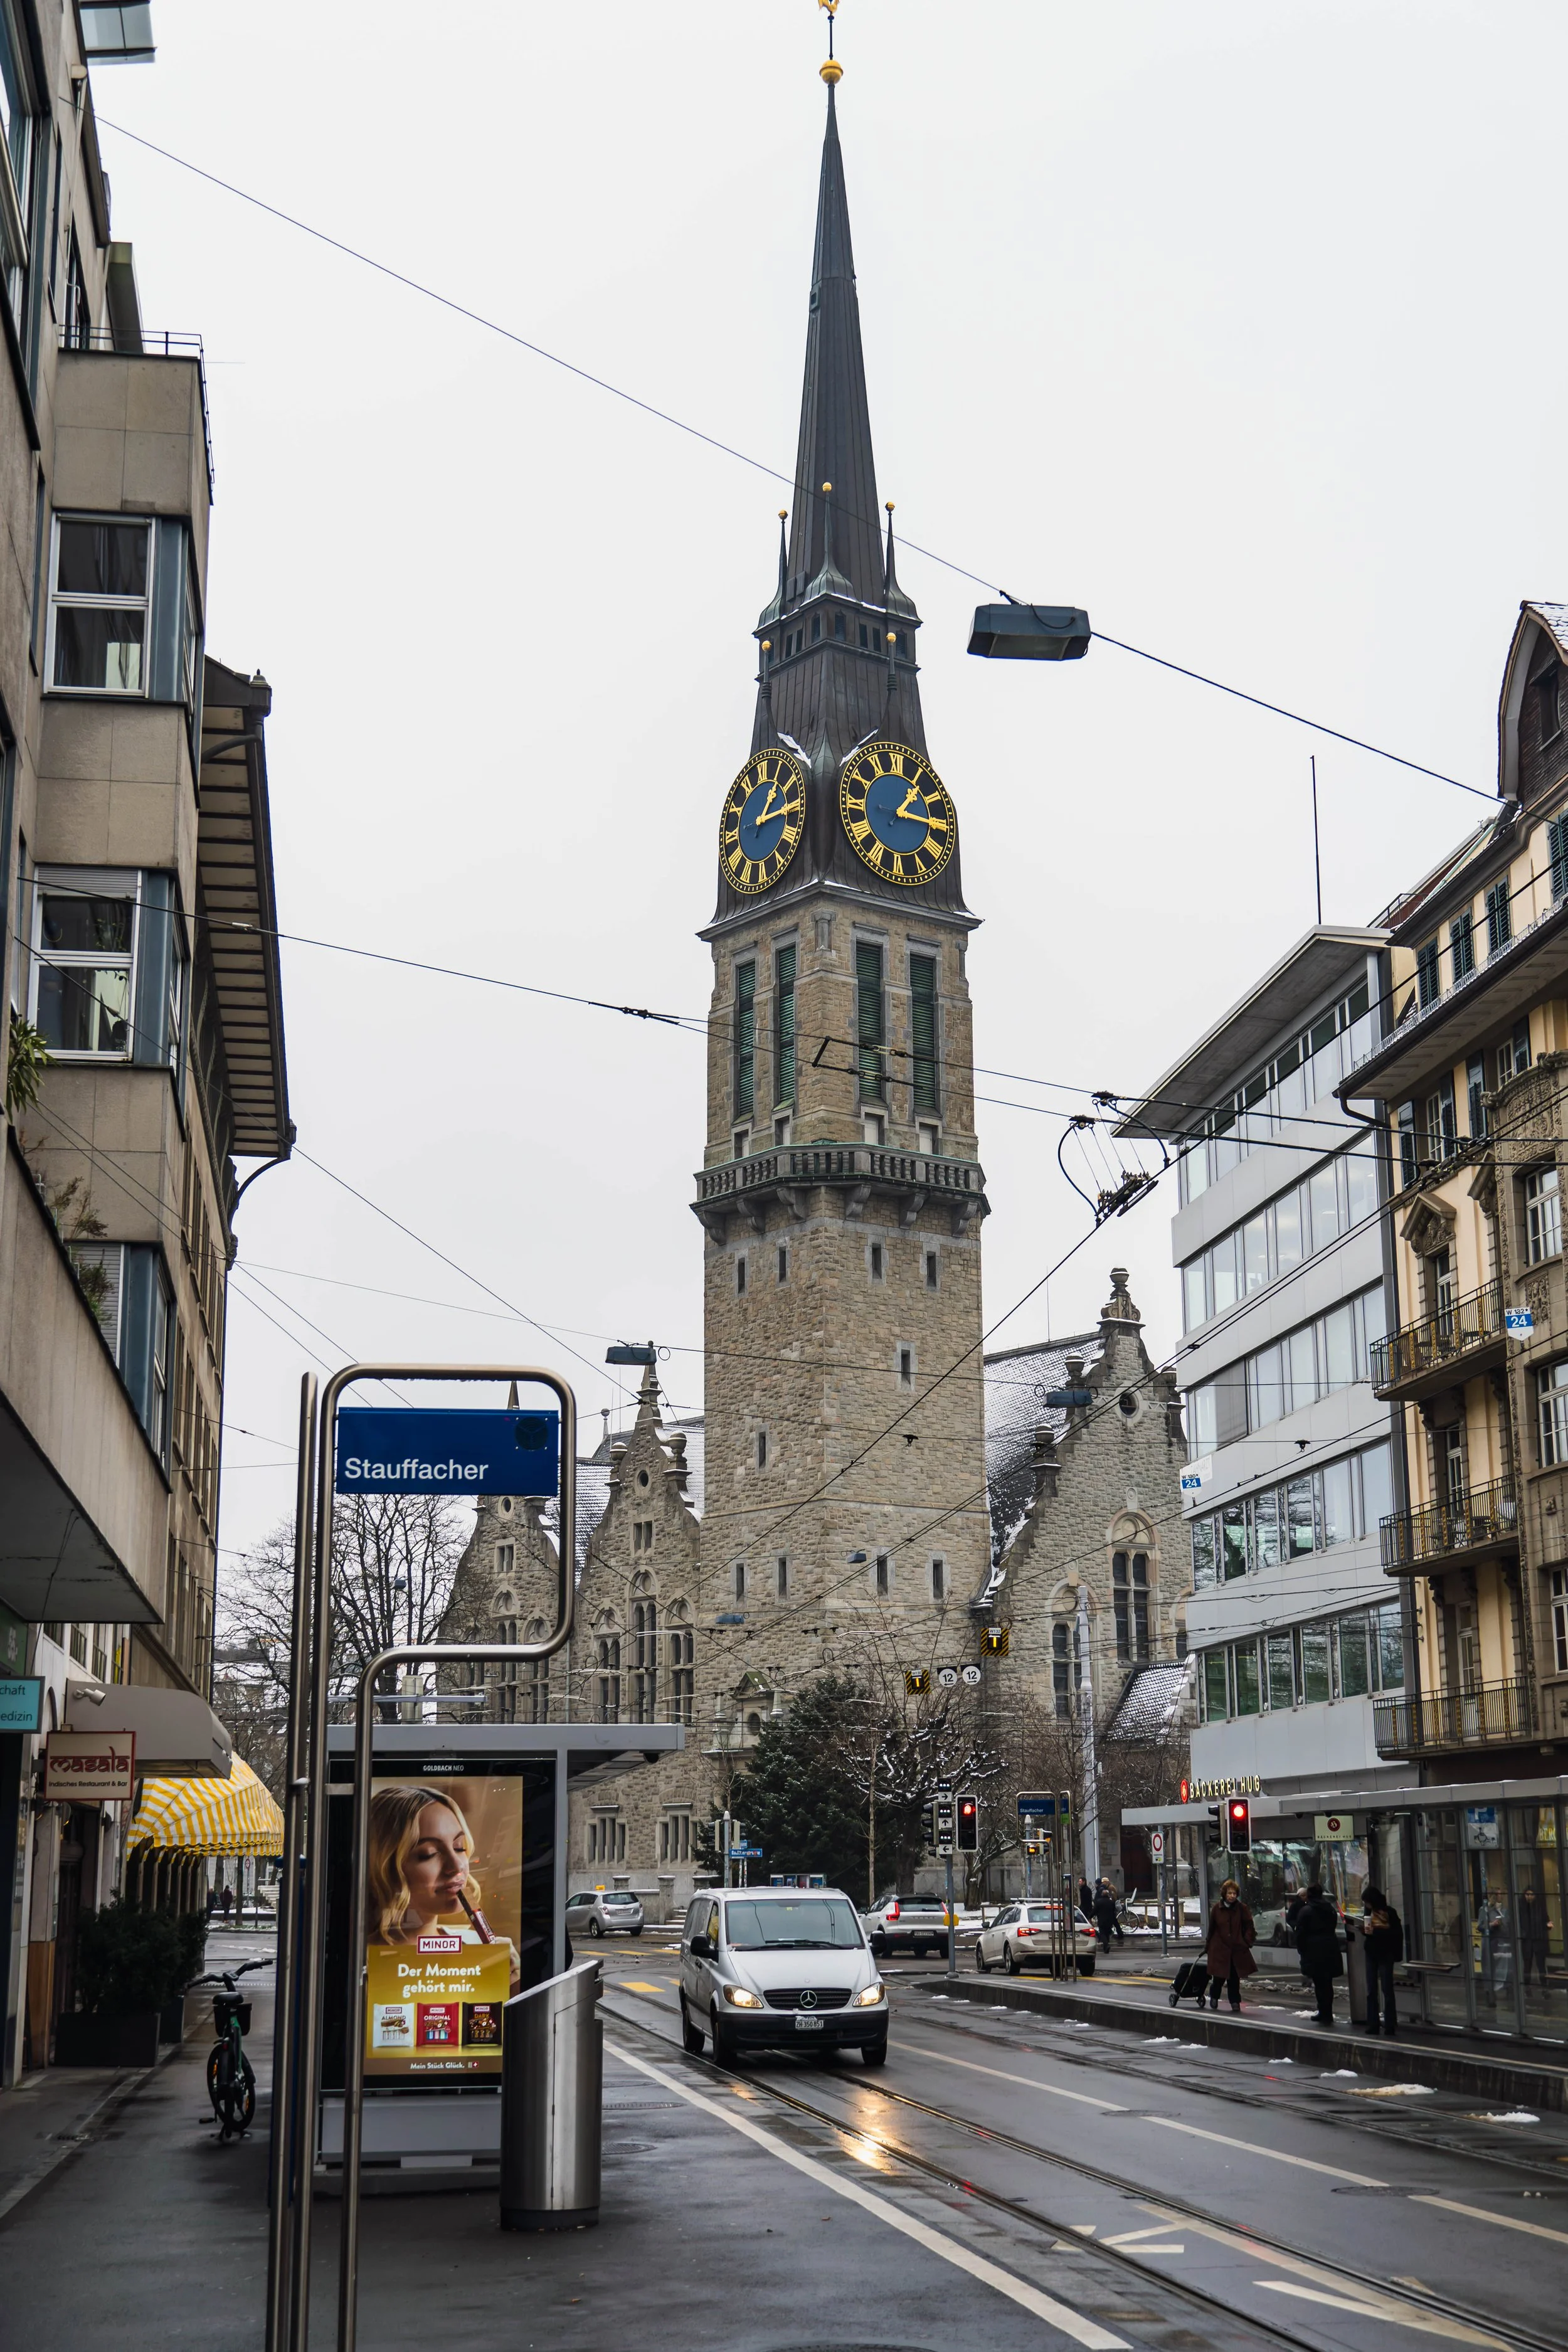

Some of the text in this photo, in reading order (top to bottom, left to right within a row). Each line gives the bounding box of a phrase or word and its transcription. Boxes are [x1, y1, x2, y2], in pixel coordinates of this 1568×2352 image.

[1511, 1315, 1527, 1327] 24
[345, 1458, 489, 1480] Stauffacher
[1185, 1479, 1197, 1488] 24
[942, 1673, 953, 1682] 12
[967, 1671, 977, 1680] 12
[1, 1711, 33, 1721] edizin
[50, 1745, 130, 1773] masala
[1190, 1774, 1260, 1798] BÄCKEREI HUG
[423, 1940, 457, 1949] MINOR
[398, 1963, 481, 1977] Der Moment
[403, 1979, 475, 1998] gehört mir.
